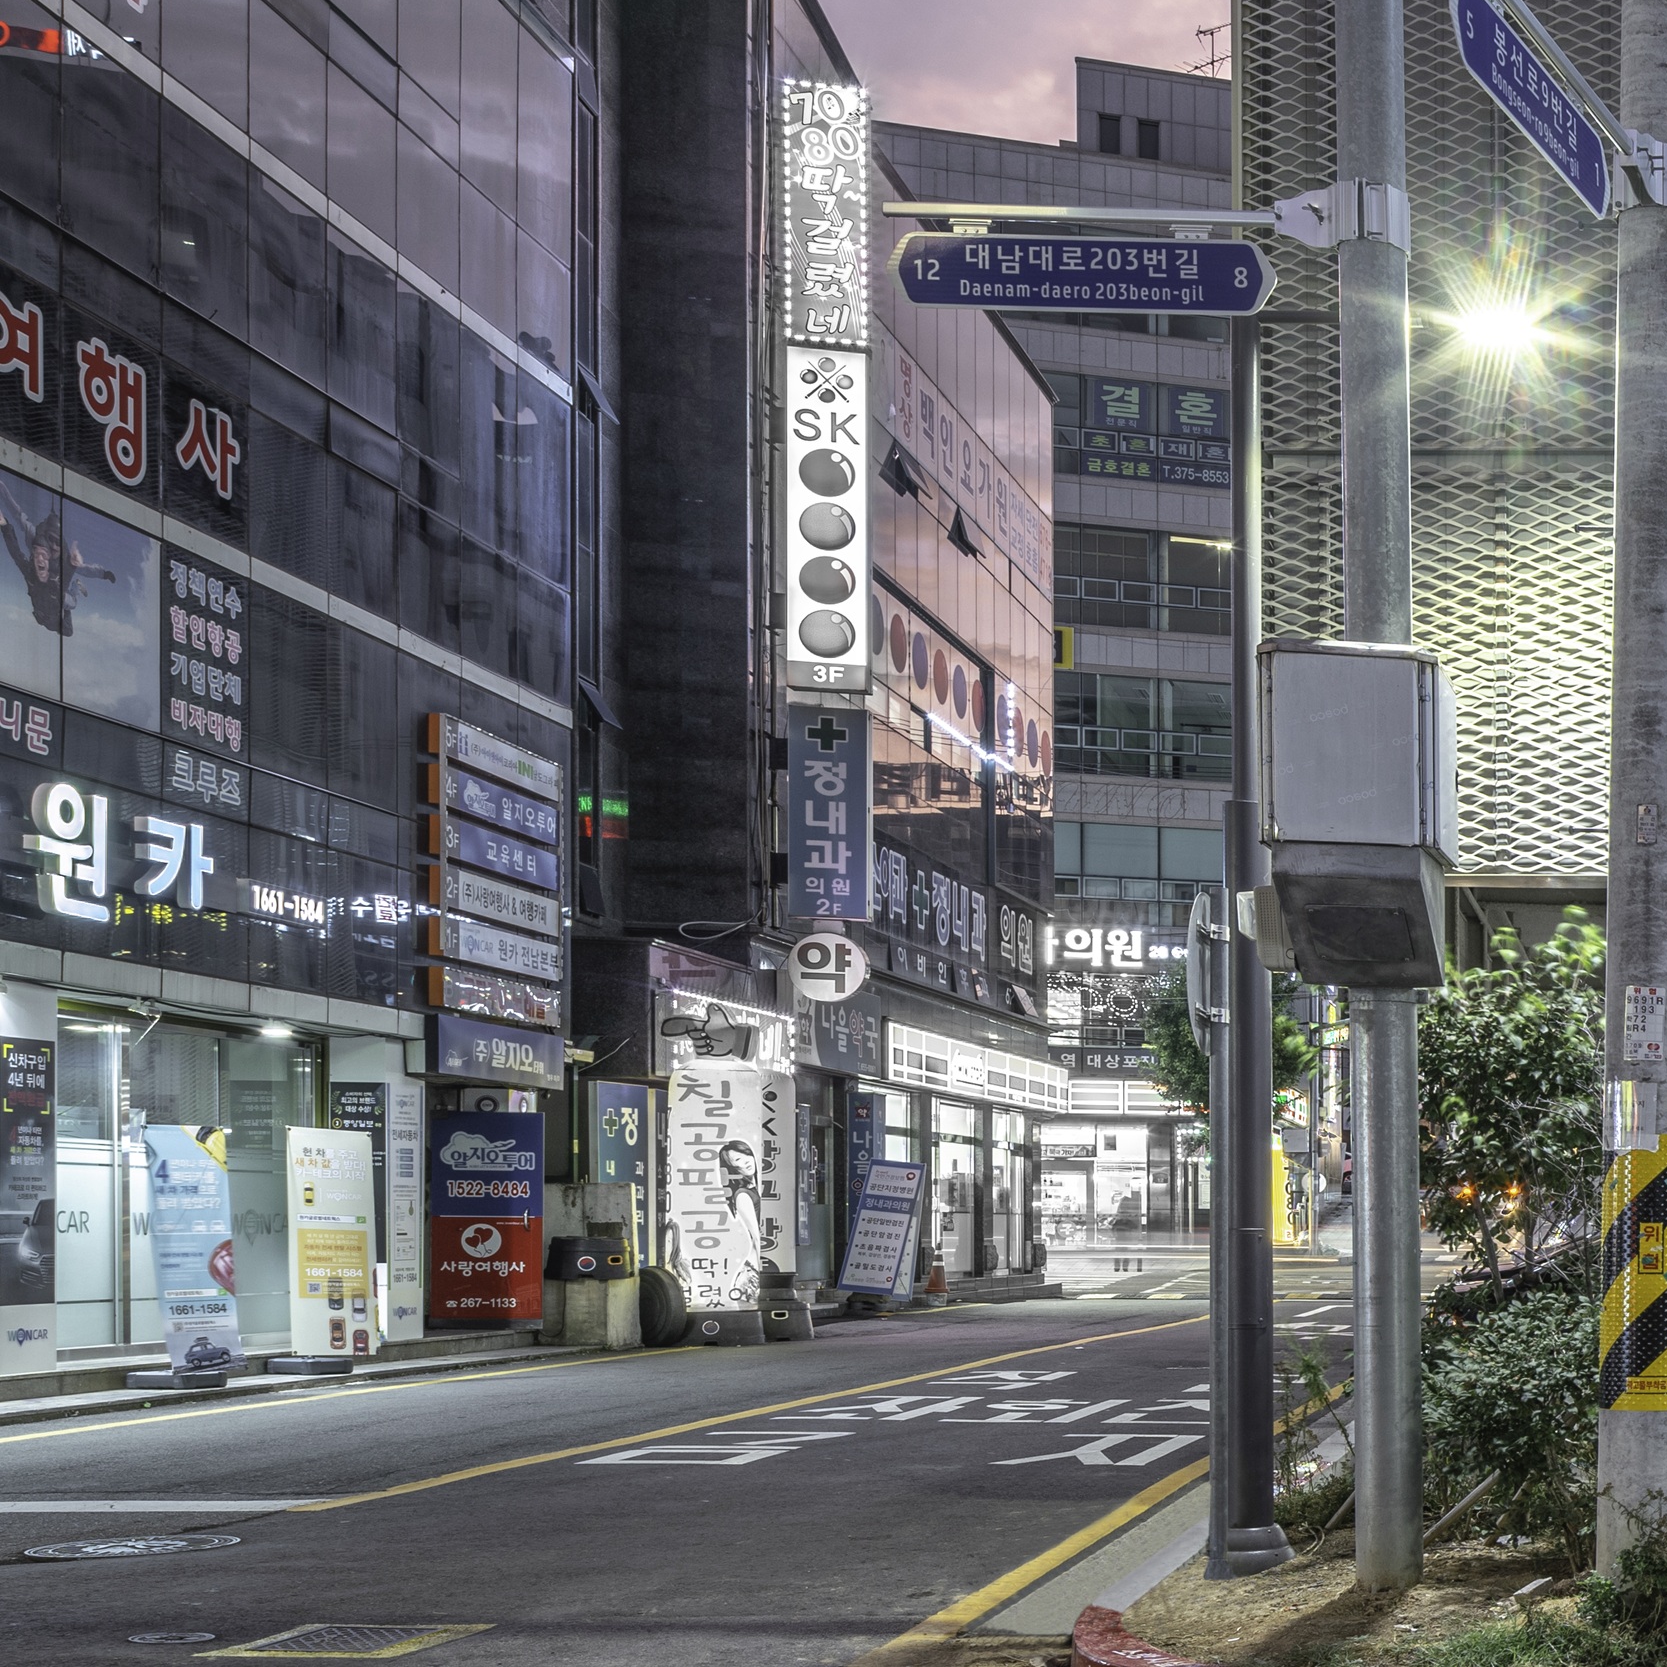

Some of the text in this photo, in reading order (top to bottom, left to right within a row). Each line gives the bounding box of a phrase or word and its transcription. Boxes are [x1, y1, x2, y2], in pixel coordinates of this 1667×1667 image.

[1466, 9, 1601, 188] 5 봉선로9번길 1
[1490, 61, 1544, 138] Bongseon-ro
[913, 243, 1248, 289] 12 대남대로203번길 8
[960, 279, 1205, 305] Daenam-daero 203beon-gil
[792, 408, 861, 446] SK
[1087, 457, 1151, 478] 금호결혼
[1163, 465, 1229, 484] T.375-8553
[170, 559, 243, 620] 정책연수
[170, 605, 243, 665] 할인항공
[170, 651, 243, 706] 기업단체
[812, 665, 844, 684] 3F
[170, 696, 243, 753] 비자대행
[171, 751, 242, 807] 크루즈
[502, 797, 557, 839] 알지오투어
[803, 758, 852, 875] 정내과
[486, 841, 538, 877] 교육센터
[804, 877, 851, 896] 의원
[251, 884, 326, 924] 1661-1584
[816, 898, 843, 916] 2F
[932, 870, 1033, 976] 정내과 의원
[796, 941, 852, 994] 약
[1627, 995, 1664, 1006] 9691R
[1634, 1005, 1655, 1014] 193
[821, 1003, 879, 1060] 나을약국
[1633, 1014, 1647, 1024] 72
[1633, 1023, 1647, 1033] R4
[8, 1052, 47, 1070] 신차구입
[450, 1146, 535, 1171] 알지오투어
[447, 1180, 530, 1198] 1522-8484
[865, 1197, 911, 1212] 정내과의원
[305, 1267, 363, 1278] 1661-1584
[440, 1261, 526, 1277] 사랑여행사
[168, 1303, 228, 1316] 1661-1584
[460, 1298, 517, 1308] 267-1133
